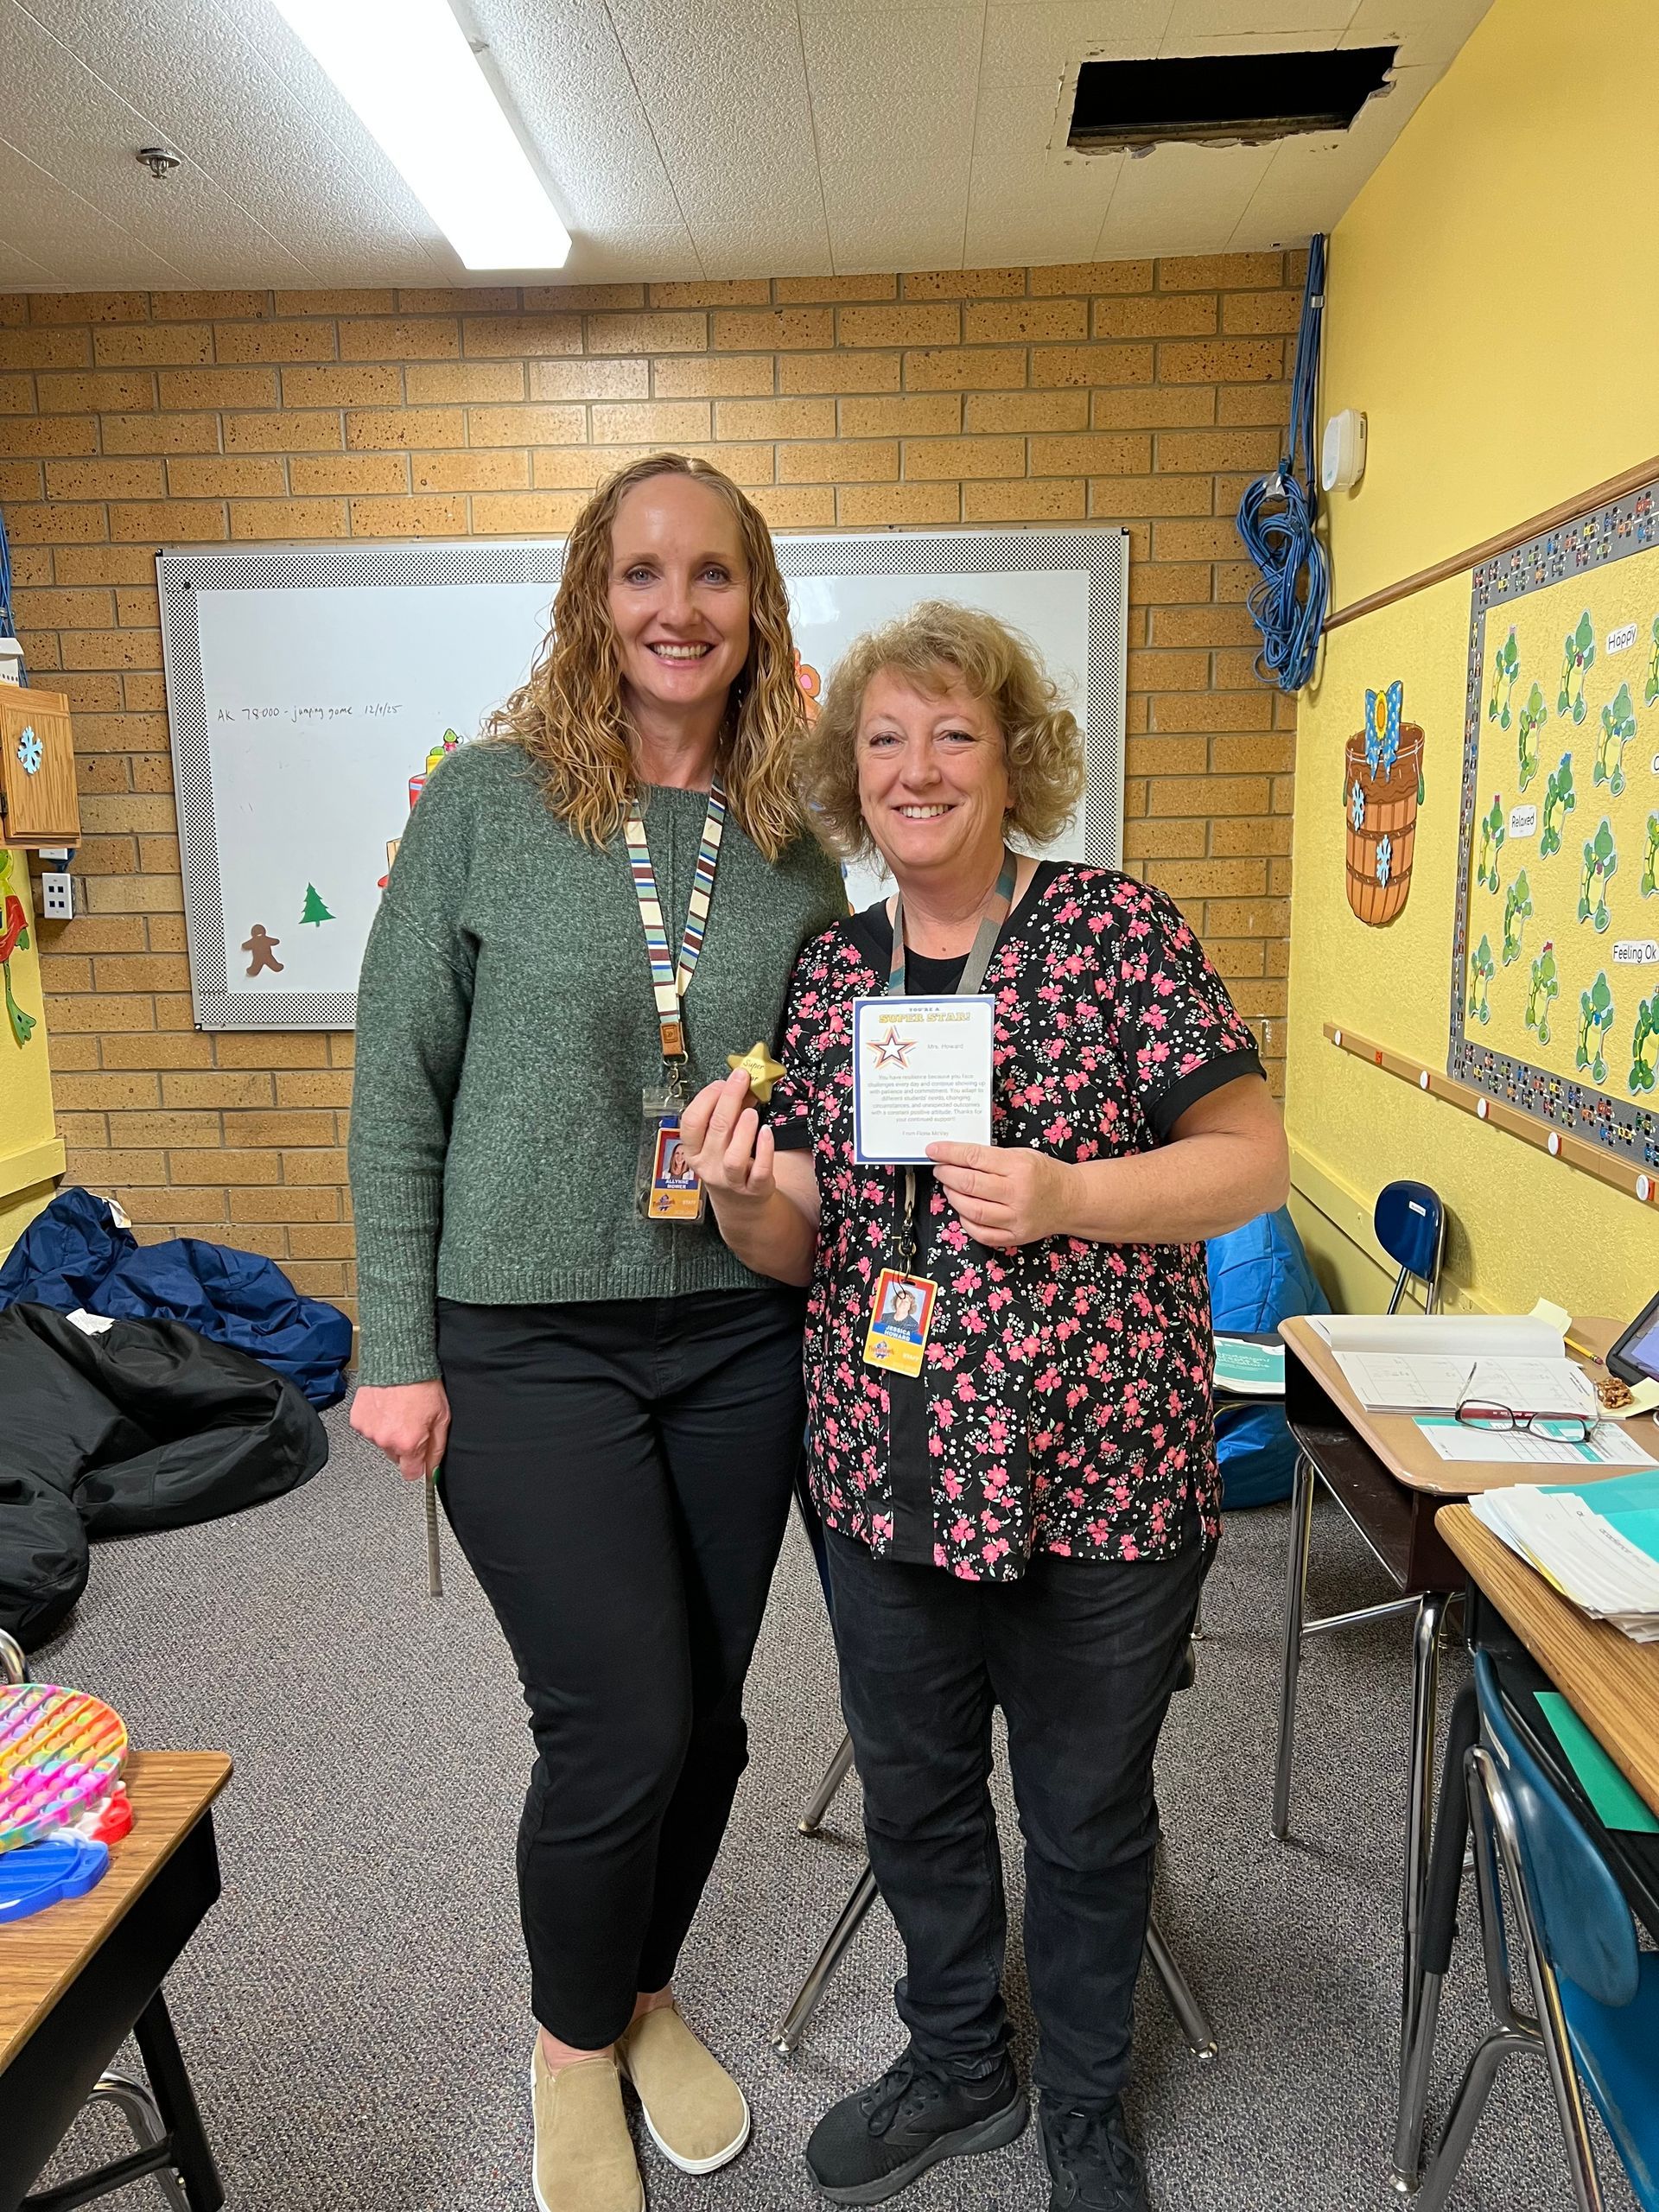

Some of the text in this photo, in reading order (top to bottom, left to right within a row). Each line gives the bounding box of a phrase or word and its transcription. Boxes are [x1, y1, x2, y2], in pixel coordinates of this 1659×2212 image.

[1608, 628, 1637, 649] Happy
[217, 709, 236, 722] AK
[291, 704, 323, 723] jumping
[1511, 812, 1535, 828] Relaxed
[1613, 944, 1657, 963] Feeling Ok
[879, 1011, 971, 1024] SUPER STAR!
[884, 1330, 911, 1342] HOWARD
[886, 1325, 911, 1336] JESSICA
